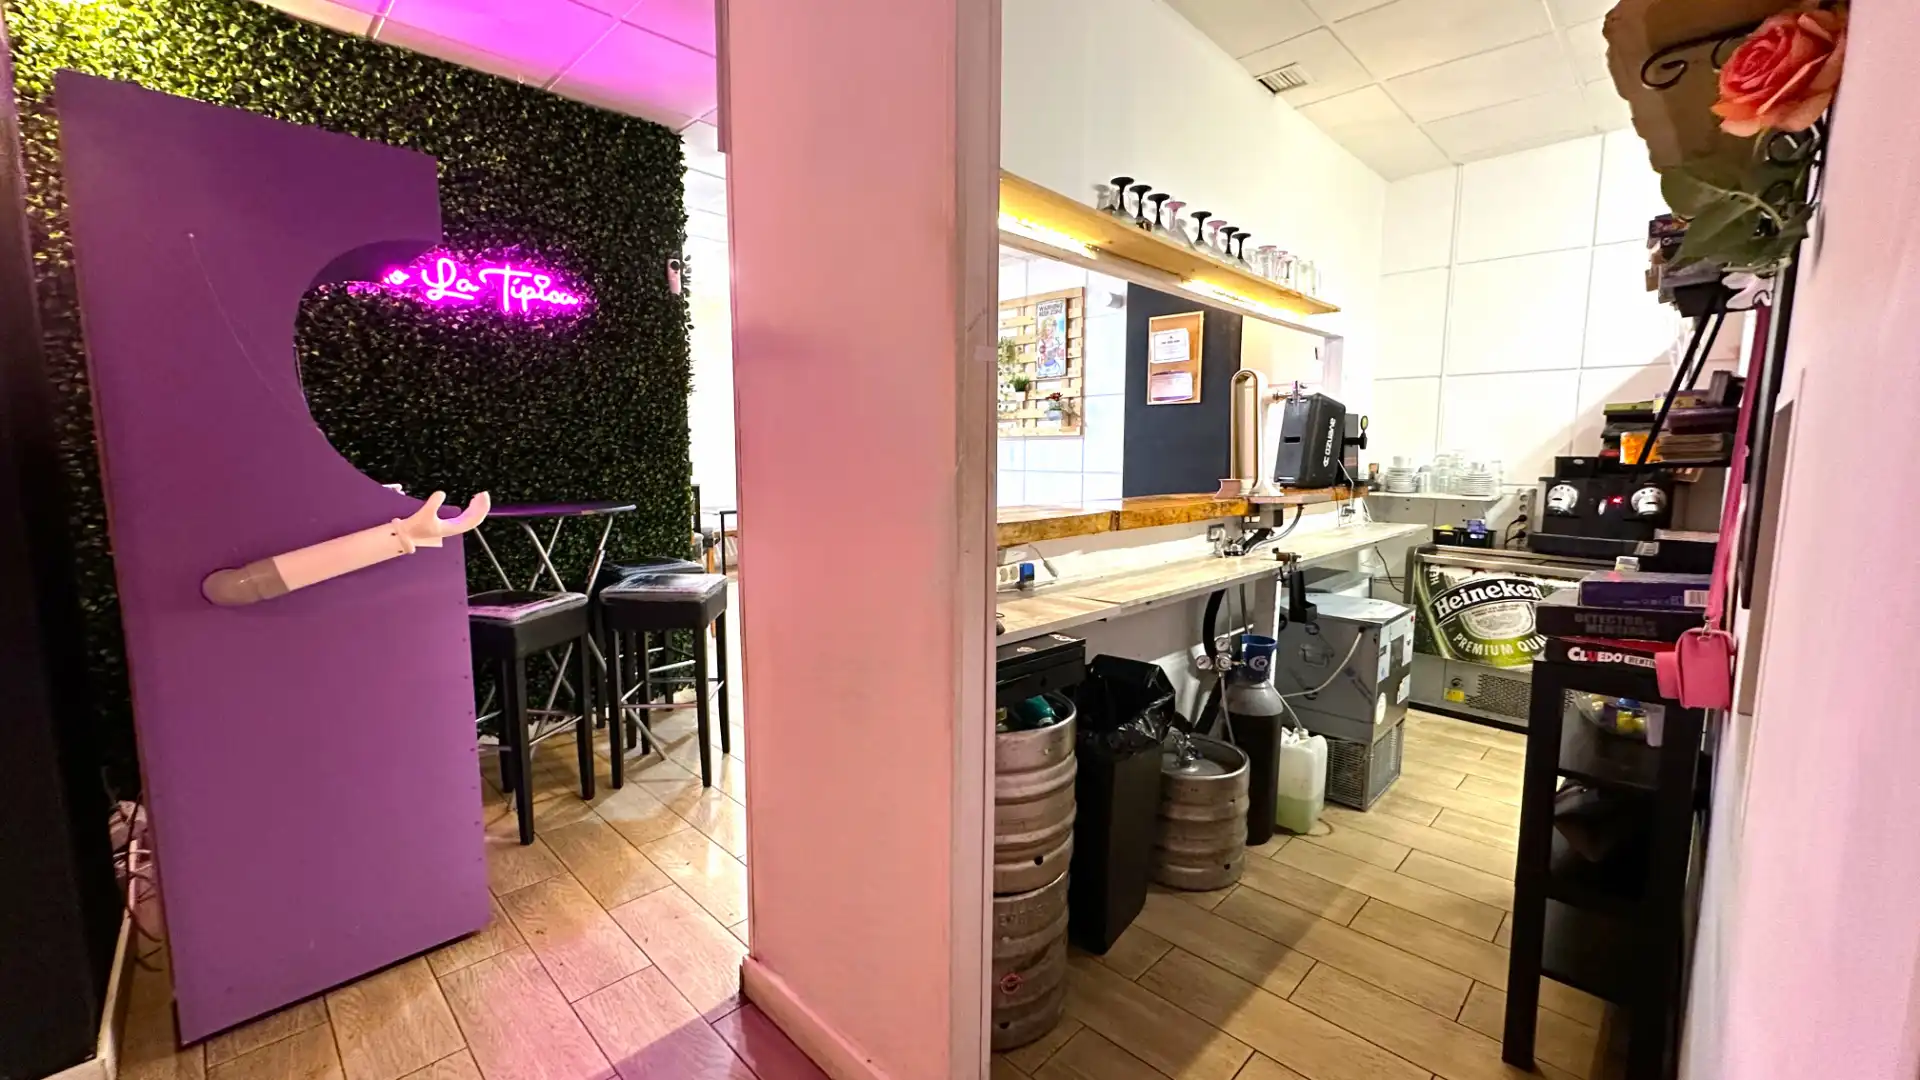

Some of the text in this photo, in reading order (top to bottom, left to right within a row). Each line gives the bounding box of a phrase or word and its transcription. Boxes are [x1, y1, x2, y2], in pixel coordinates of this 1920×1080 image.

[421, 257, 480, 301] La
[1434, 580, 1543, 618] Heineken
[1453, 633, 1514, 656] PREMIUM
[1567, 646, 1622, 663] CLUEDO
